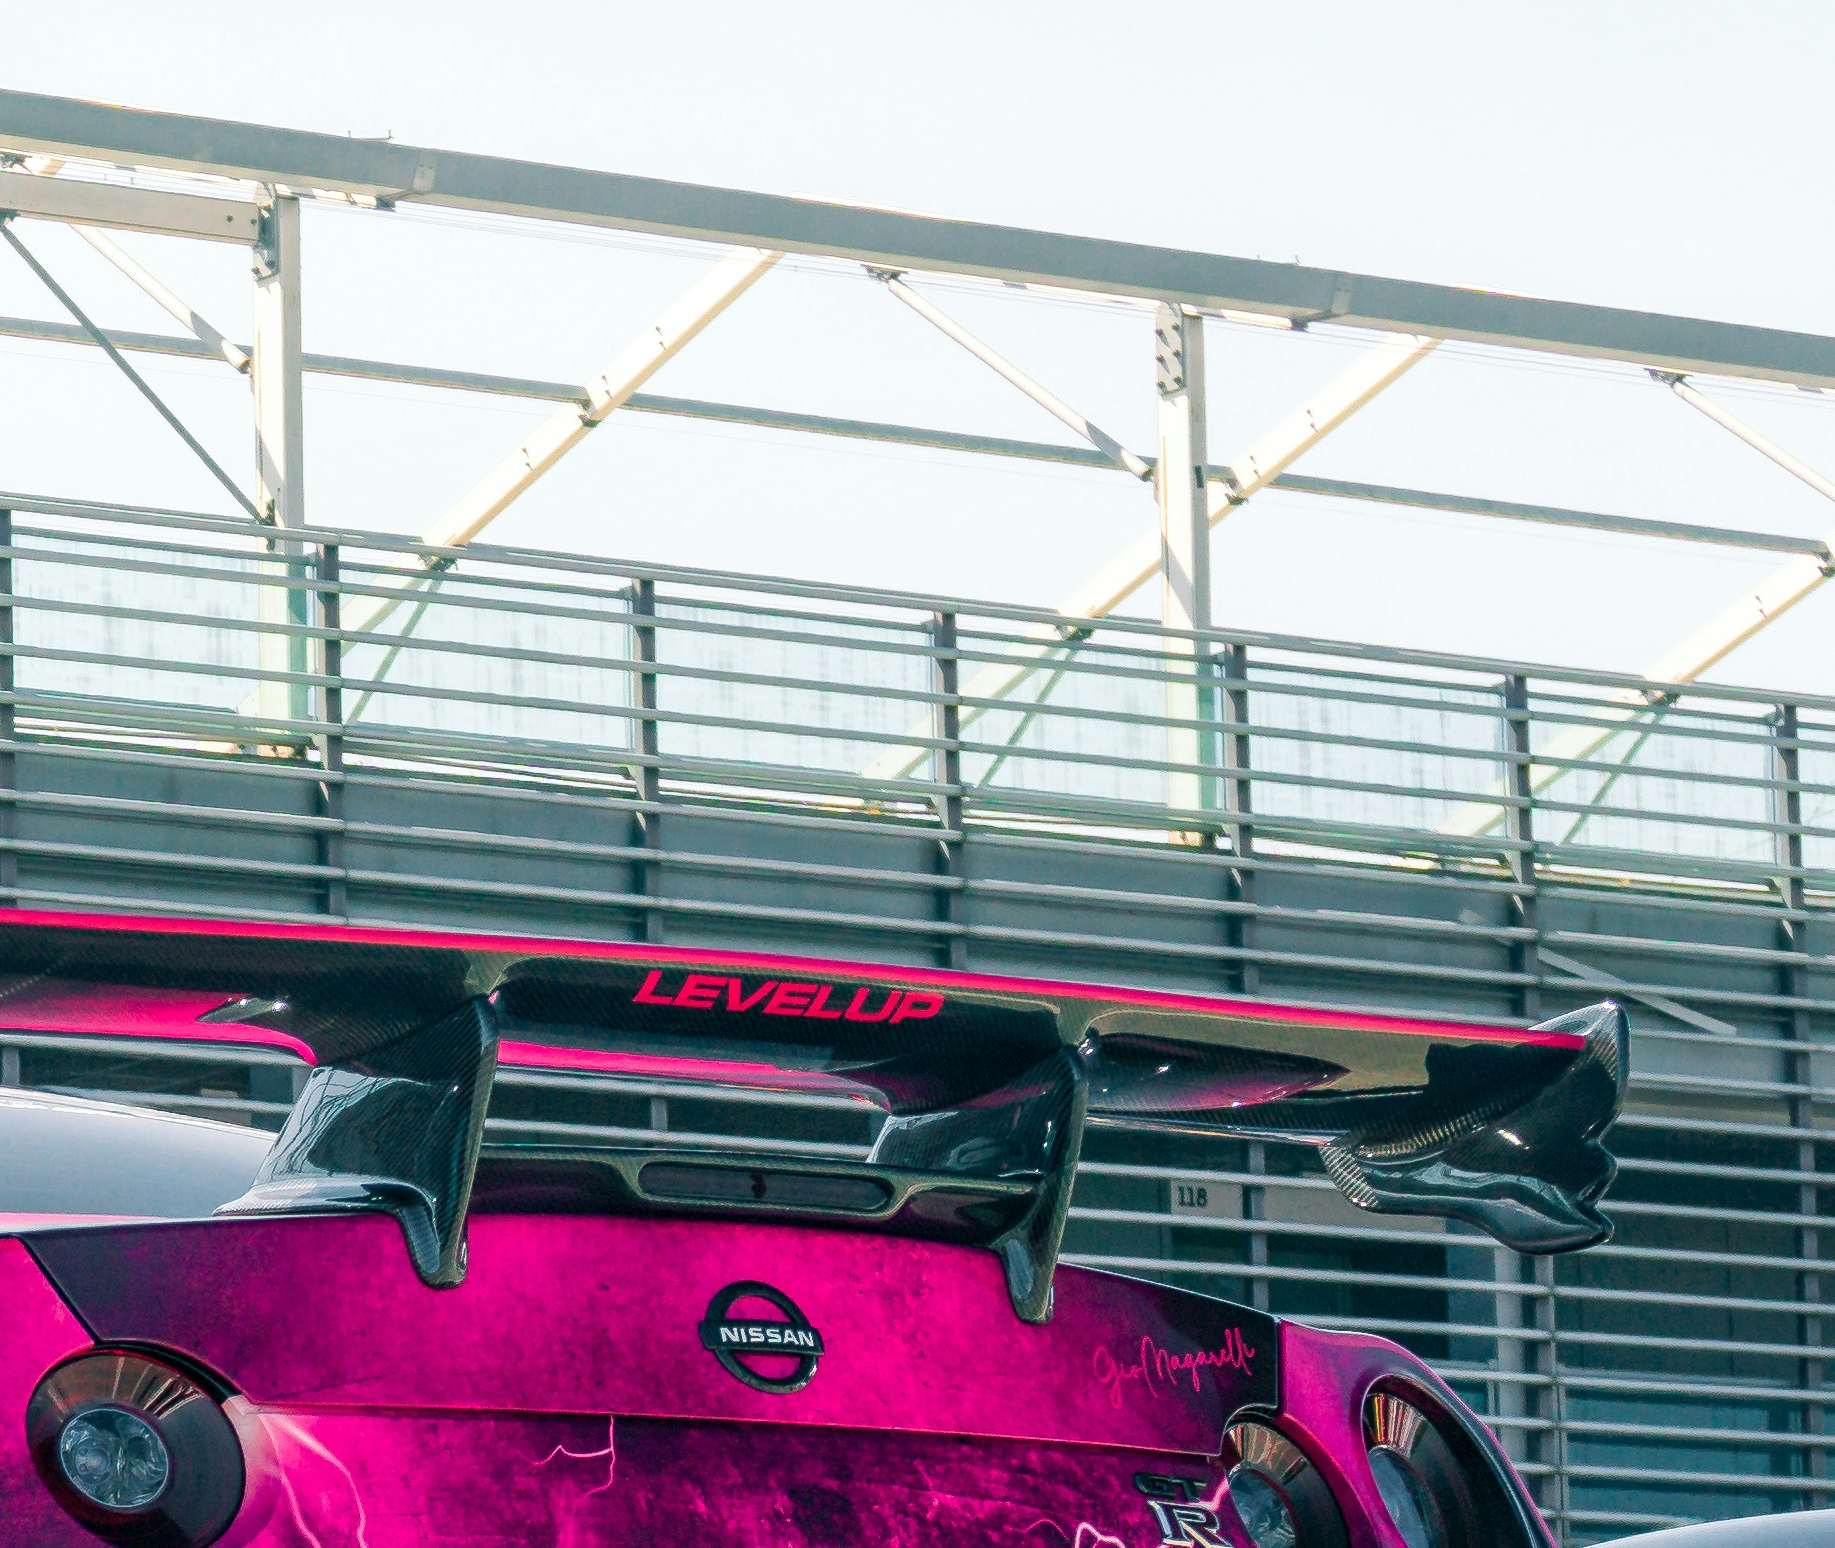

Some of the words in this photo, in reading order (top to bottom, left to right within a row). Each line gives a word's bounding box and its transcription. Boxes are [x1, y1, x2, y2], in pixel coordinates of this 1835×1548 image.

[632, 969, 945, 1024] LEVELUP
[1176, 1185, 1209, 1208] 118
[720, 1326, 814, 1348] NISSAN
